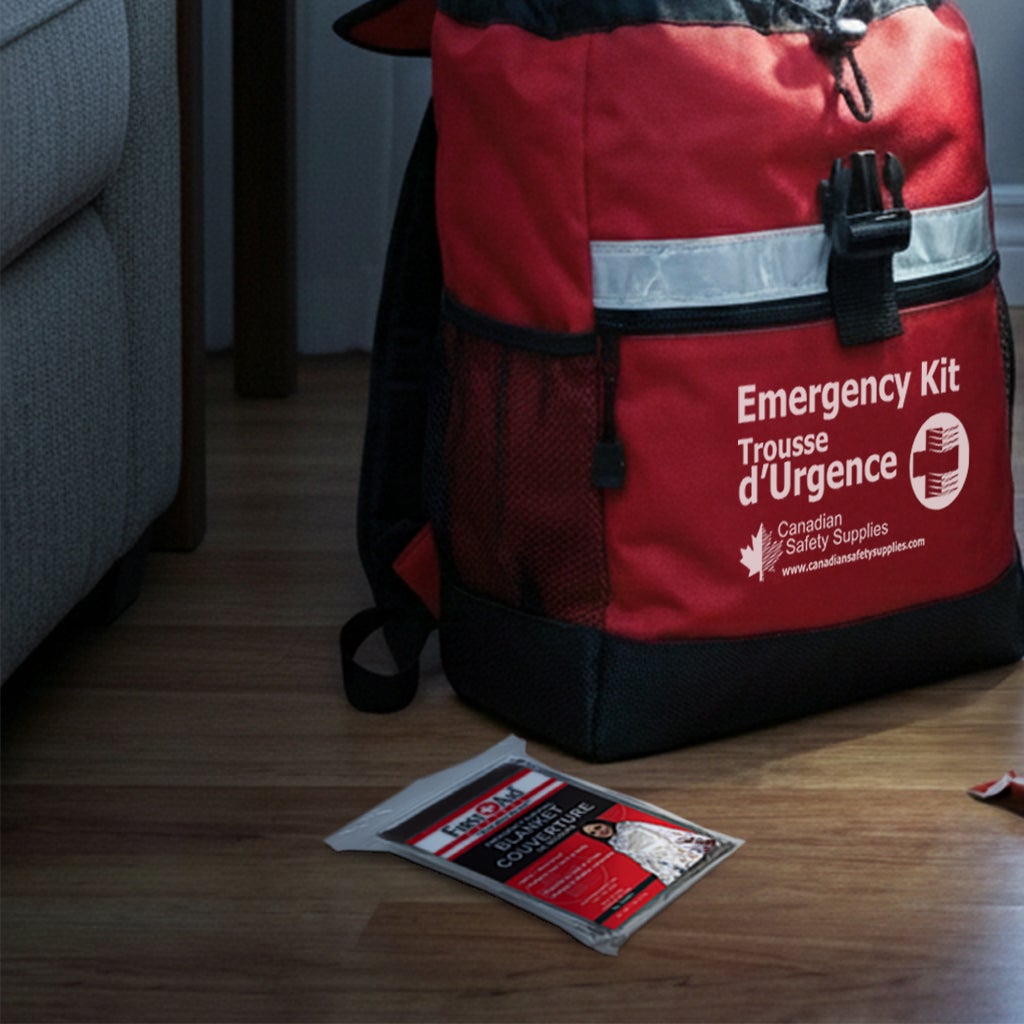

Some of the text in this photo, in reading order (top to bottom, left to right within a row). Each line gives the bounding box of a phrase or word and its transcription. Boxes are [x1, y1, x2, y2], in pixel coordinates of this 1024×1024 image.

[737, 357, 960, 424] Emergency Kit
[737, 431, 829, 465] Trousse
[738, 451, 898, 507] d'Urgence
[777, 513, 843, 538] Canadian
[785, 522, 889, 556] Safety Supplies
[781, 537, 926, 577] www.canadiansafetysupplies.com
[494, 803, 563, 852] BLANKET
[496, 801, 596, 869] COUVERTURE
